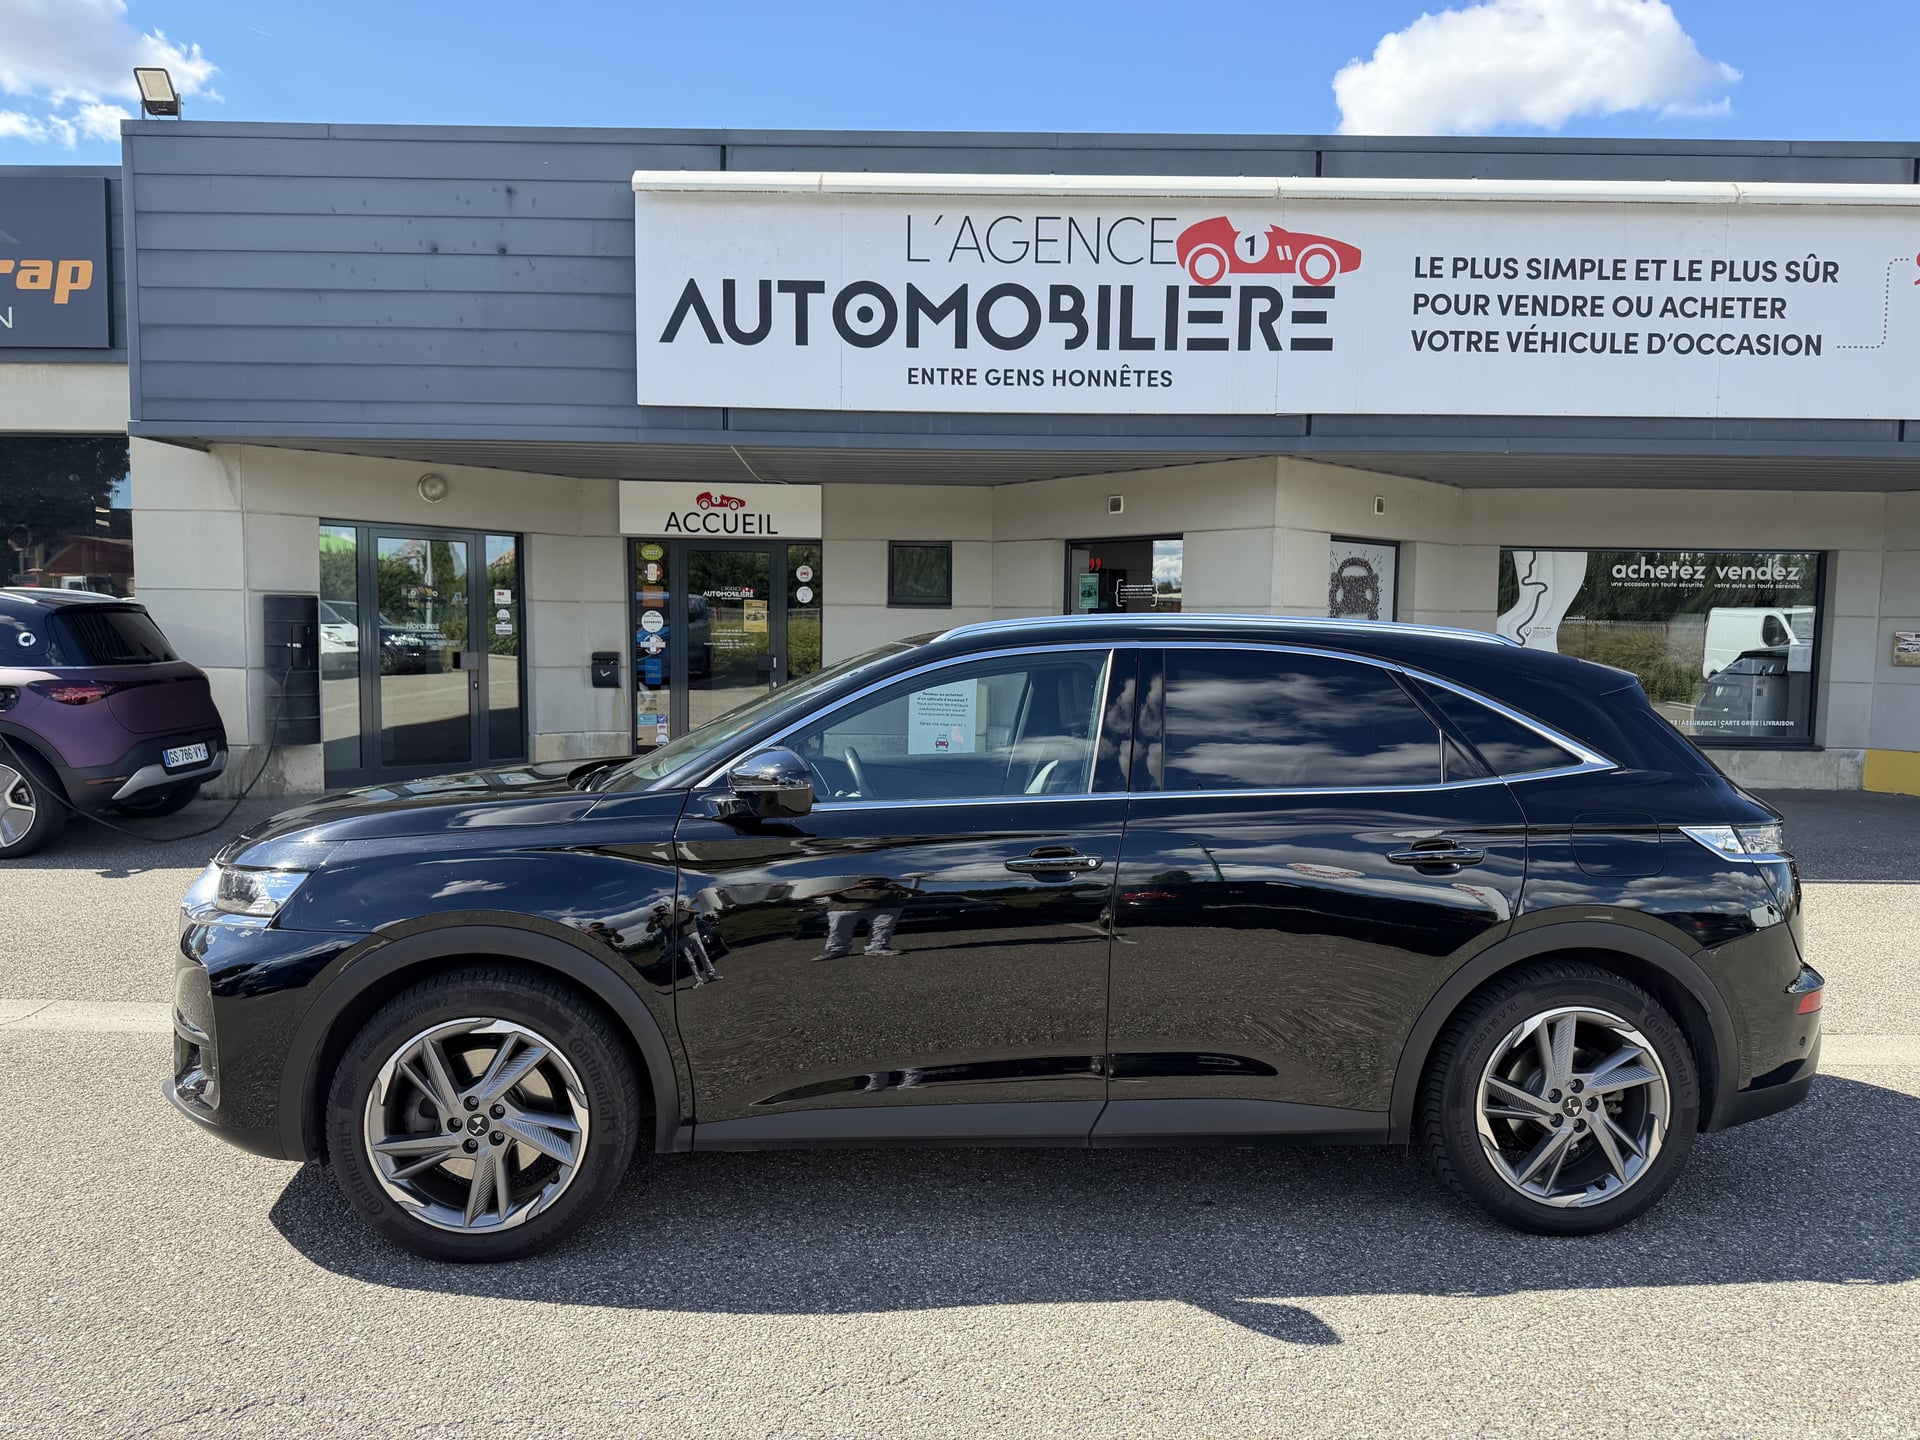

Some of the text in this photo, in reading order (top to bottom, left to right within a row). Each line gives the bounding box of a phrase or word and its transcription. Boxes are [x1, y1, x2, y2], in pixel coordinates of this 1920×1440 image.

[1415, 254, 1839, 283] LE PLUS SIMPLE ET LE PLUS SÛR
[1414, 294, 1786, 319] POUR VENDRE OU ACHETER
[1411, 324, 1821, 355] VOTRE VÉHICULE D'OCCASION
[908, 364, 1172, 387] ENTRE GENS HONNÊTES
[665, 512, 778, 534] ACCUEIL
[1612, 557, 1800, 581] achetez vendez
[1466, 1033, 1488, 1063] 235/50
[568, 1035, 614, 1119] Continental
